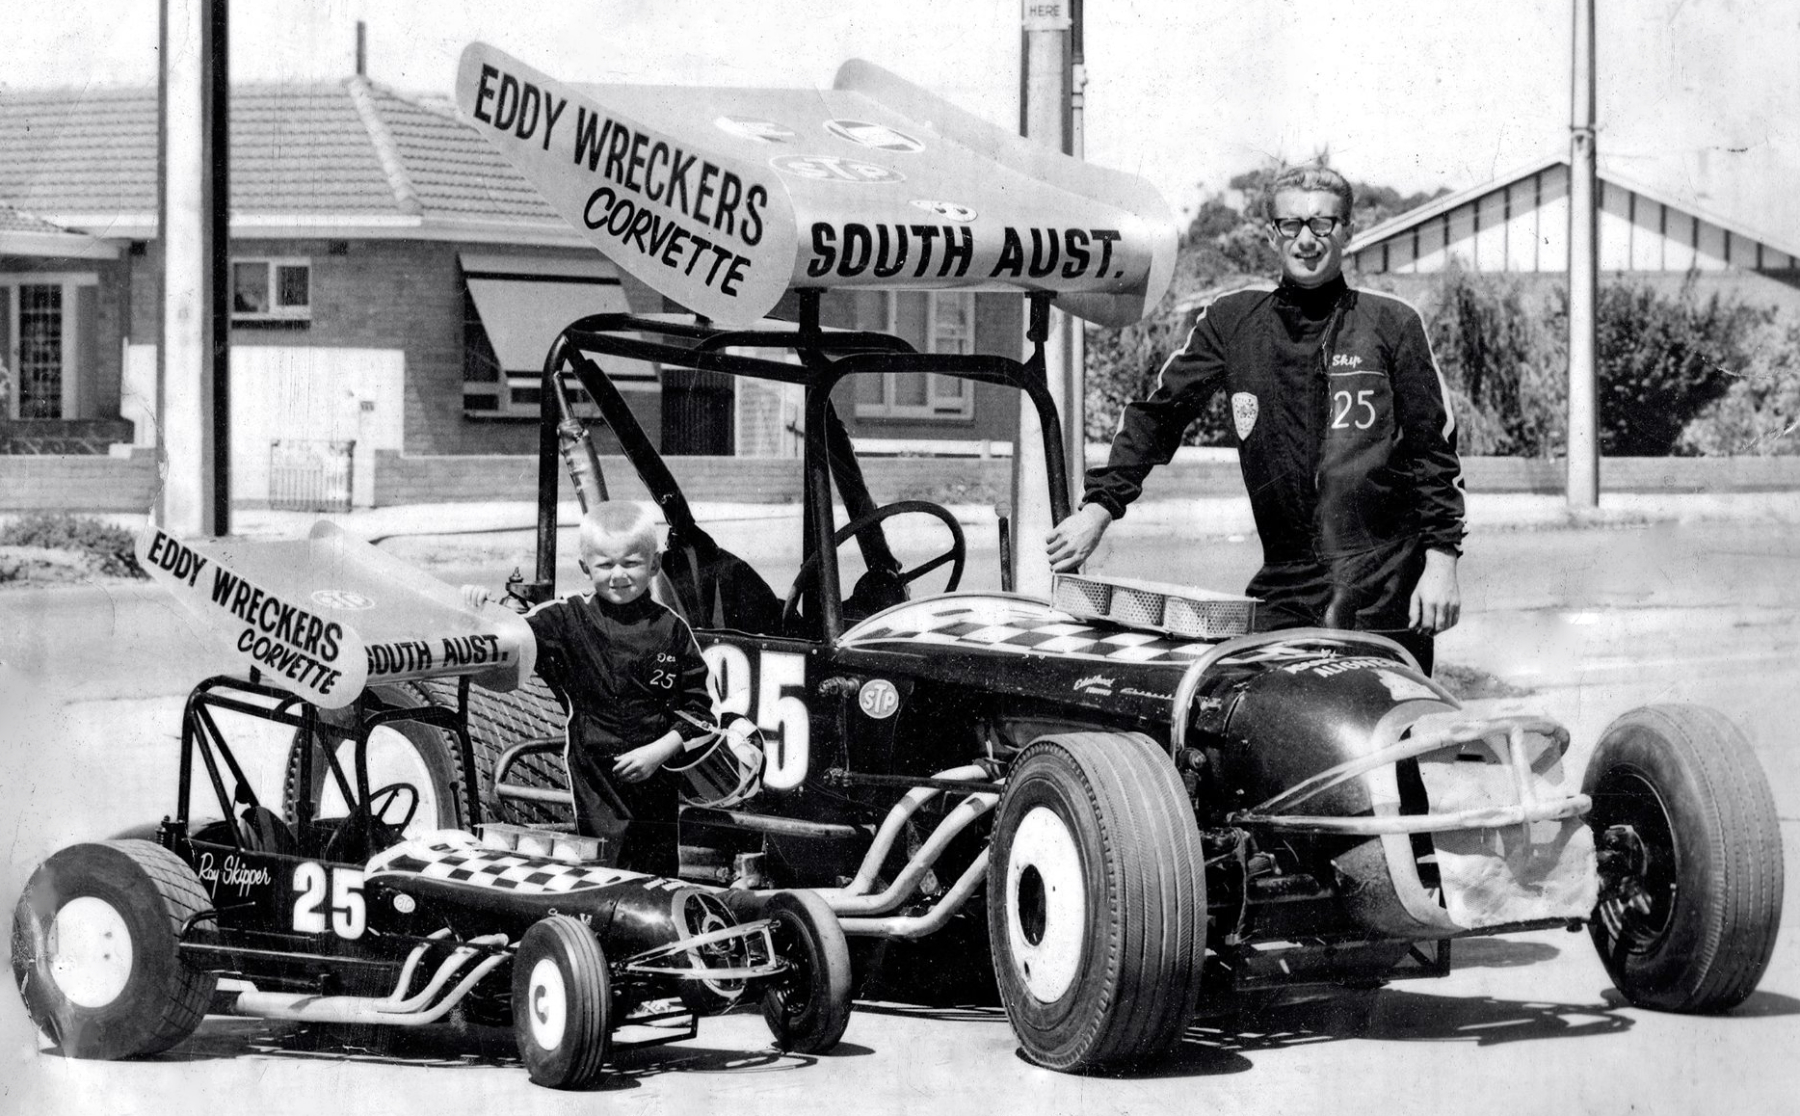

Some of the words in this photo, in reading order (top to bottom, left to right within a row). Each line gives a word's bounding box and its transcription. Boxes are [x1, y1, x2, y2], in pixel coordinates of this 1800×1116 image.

[473, 63, 568, 151] EDDY
[574, 105, 768, 246] WRECKERS
[583, 186, 752, 297] CORVETTE
[807, 222, 975, 277] SOUTH
[990, 226, 1124, 278] AUST.
[1332, 353, 1363, 368] Skip
[1331, 390, 1376, 430] 25
[148, 530, 208, 587] EDDY
[211, 566, 343, 662] WRECKERS
[237, 627, 343, 695] CORVETTE
[442, 634, 509, 668] AUST.
[650, 669, 677, 689] 25
[862, 683, 897, 713] STP
[222, 853, 271, 898] Skipper
[293, 861, 366, 940] 25
